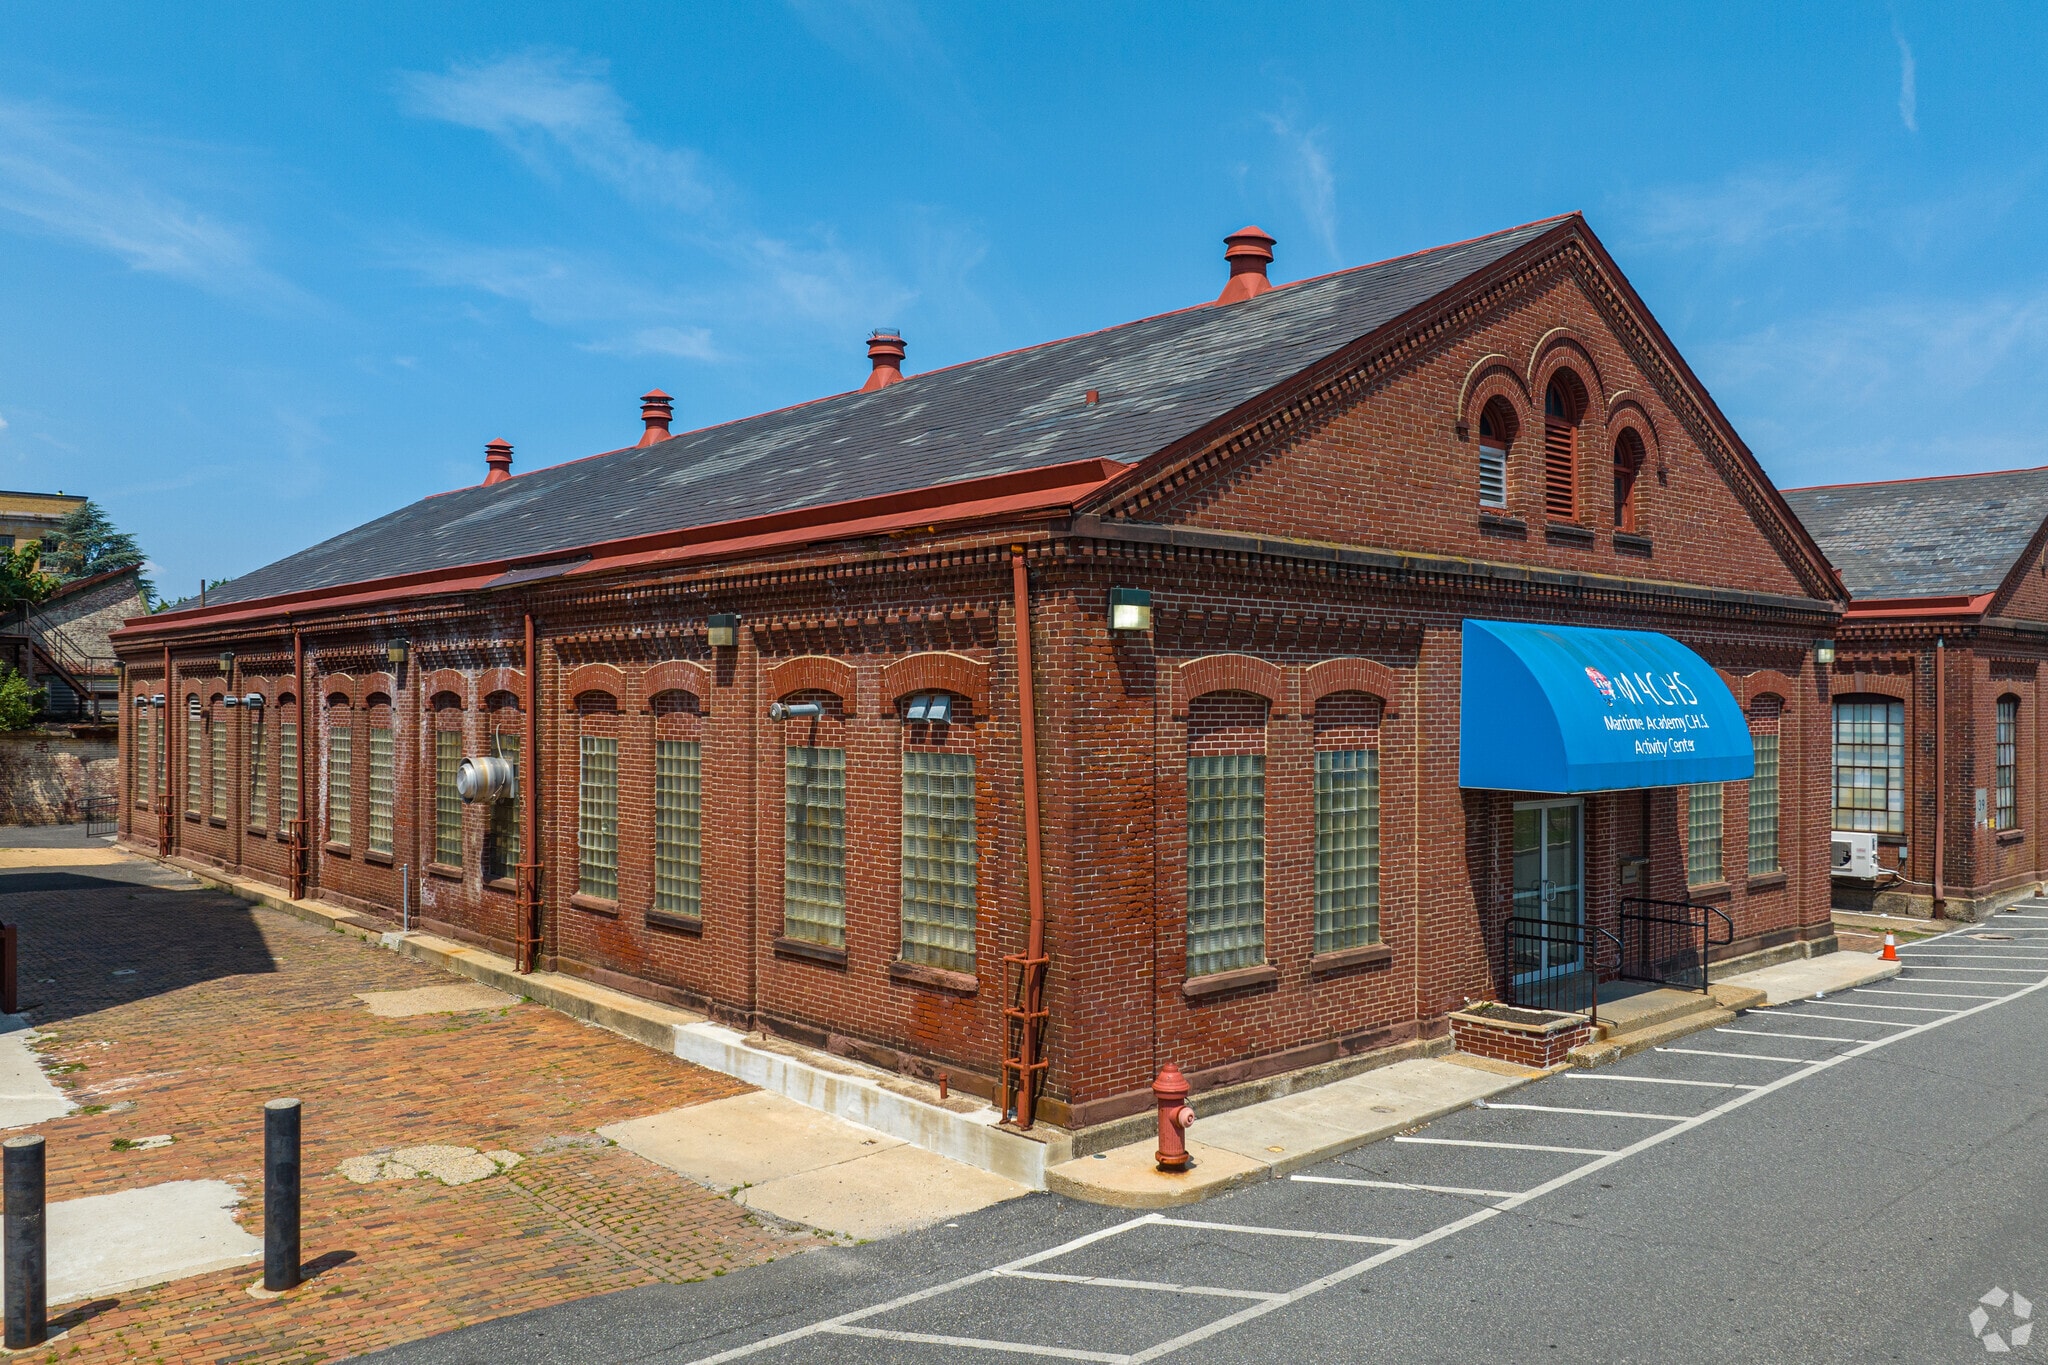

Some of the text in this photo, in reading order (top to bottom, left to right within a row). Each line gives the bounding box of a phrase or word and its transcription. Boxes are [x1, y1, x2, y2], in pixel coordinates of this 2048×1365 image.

[1614, 671, 1698, 705] MACHS
[1603, 714, 1645, 731] Maritime
[1646, 714, 1686, 733] Academy
[1635, 737, 1696, 757] Activity Center
